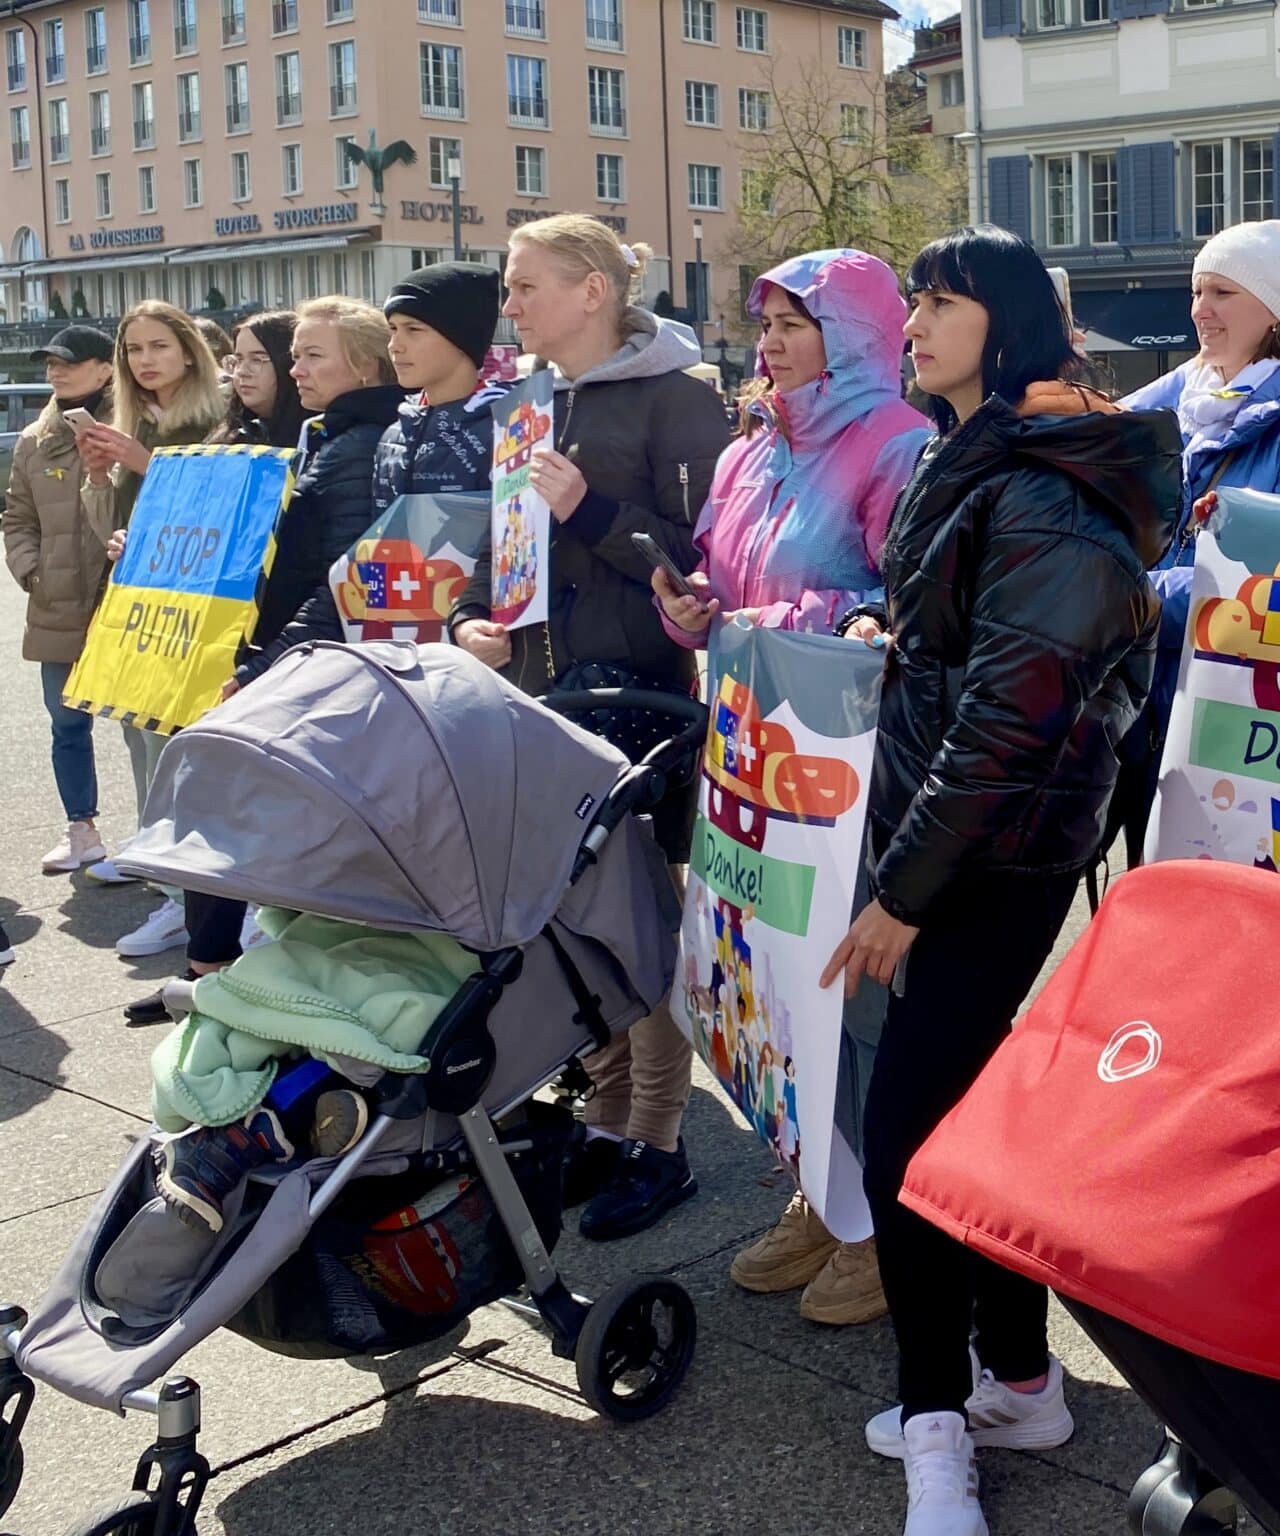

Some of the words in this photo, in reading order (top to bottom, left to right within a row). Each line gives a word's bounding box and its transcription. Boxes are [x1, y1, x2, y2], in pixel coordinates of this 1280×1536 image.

[215, 214, 262, 236] HOTEL
[273, 203, 358, 229] STORCHEN
[401, 200, 484, 225] HOTEL
[506, 208, 627, 234] STEN
[1131, 335, 1188, 344] IQOS
[150, 525, 221, 576] STOP
[118, 602, 201, 660] PUTIN
[706, 832, 763, 905] Danke!
